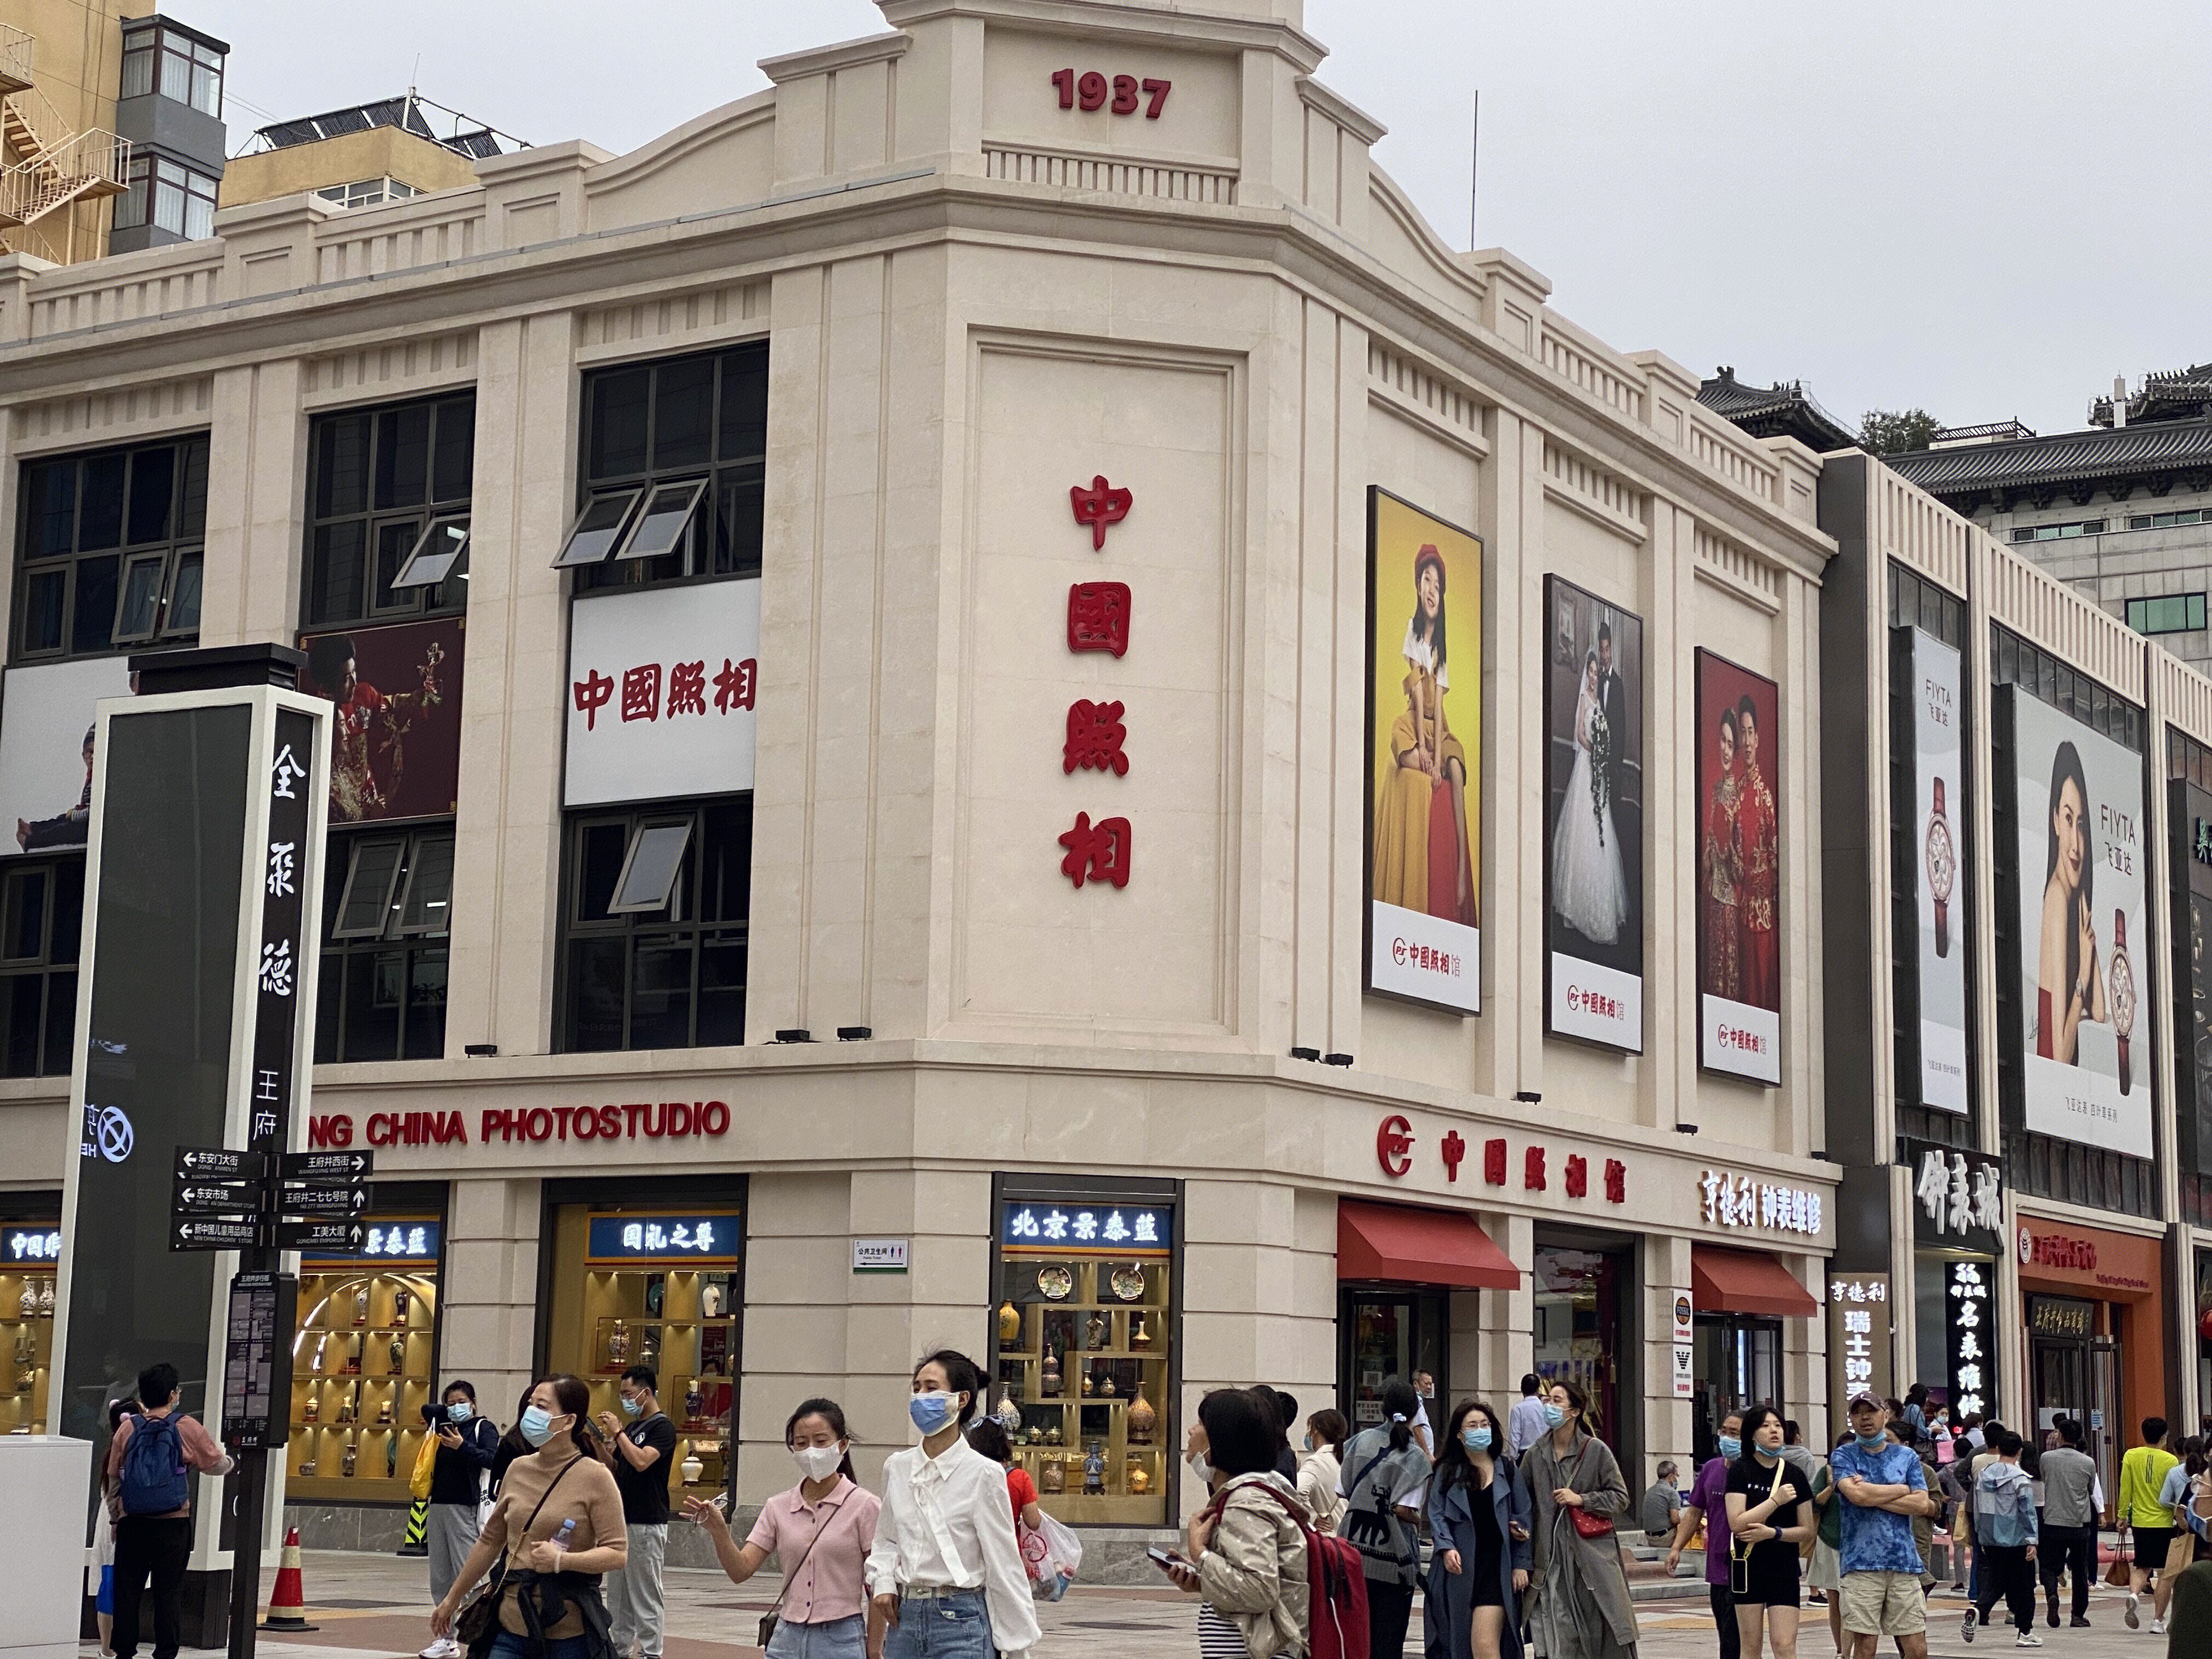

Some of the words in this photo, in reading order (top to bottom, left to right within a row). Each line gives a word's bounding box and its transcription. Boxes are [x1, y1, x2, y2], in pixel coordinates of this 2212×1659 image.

[1052, 68, 1171, 119] 1937
[573, 657, 757, 731] 中國照相
[1058, 475, 1133, 889] 中國照相
[1926, 679, 1951, 708] FIYTA
[1928, 702, 1948, 726] 飞亚达
[2101, 804, 2136, 846] FIYTA
[2104, 842, 2131, 876] 飞亚达
[366, 1110, 468, 1147] CHINA
[481, 1101, 731, 1143] PHOTOSTUDIO
[198, 1152, 239, 1166] 东安门大街
[307, 1155, 349, 1168] 王府井西街
[196, 1188, 229, 1201] 东安市场
[285, 1191, 348, 1203] 王府井二七七号院
[194, 1223, 253, 1237] 新中国儿童用品商店
[312, 1225, 346, 1237] 工美大厦
[623, 1221, 715, 1251] 国礼之尊
[1012, 1209, 1158, 1241] 北京景泰蓝
[364, 1226, 426, 1255] 景泰蓝
[1677, 1306, 1690, 1316] FOSSIL
[1844, 1311, 1871, 1433] 瑞士钟表
